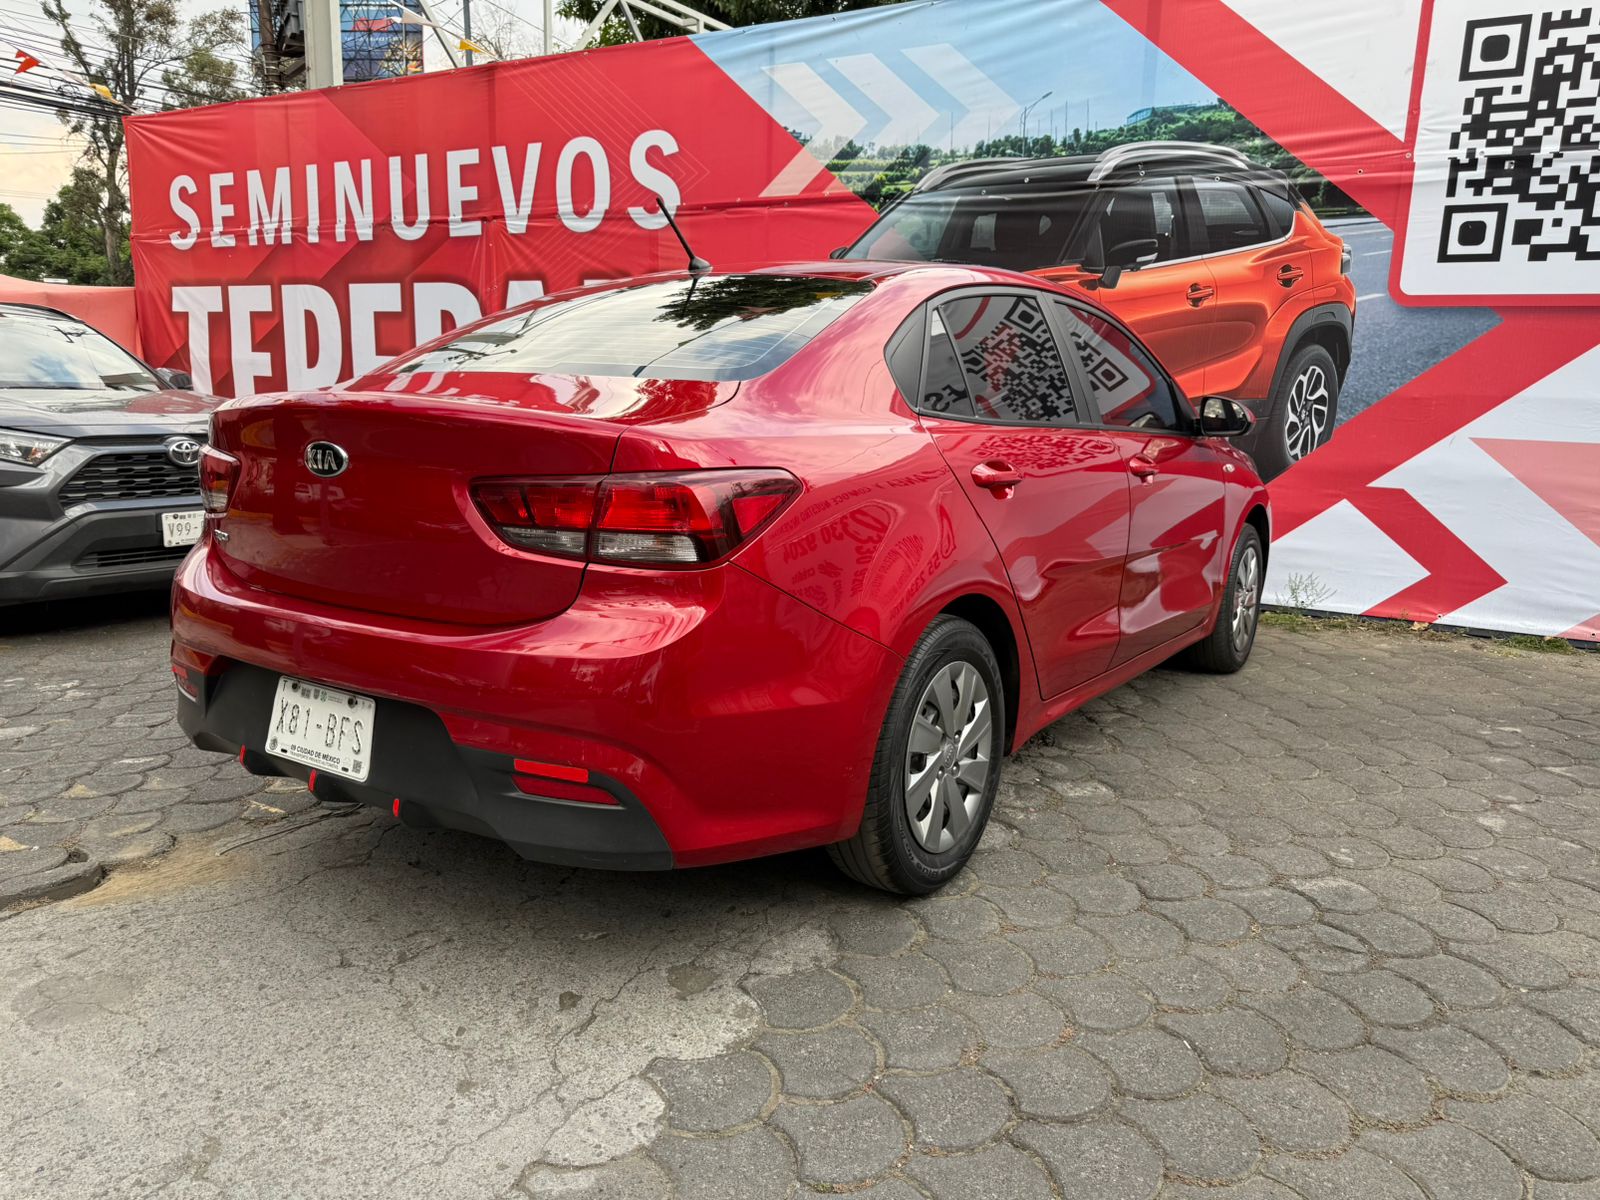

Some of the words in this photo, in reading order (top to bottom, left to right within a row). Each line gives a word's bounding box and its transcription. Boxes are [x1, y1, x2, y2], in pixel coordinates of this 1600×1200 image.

[169, 129, 681, 250] SEMINUEVOS
[307, 448, 338, 471] KIA
[276, 697, 364, 755] X81-BFS
[296, 746, 315, 757] CIUDAD
